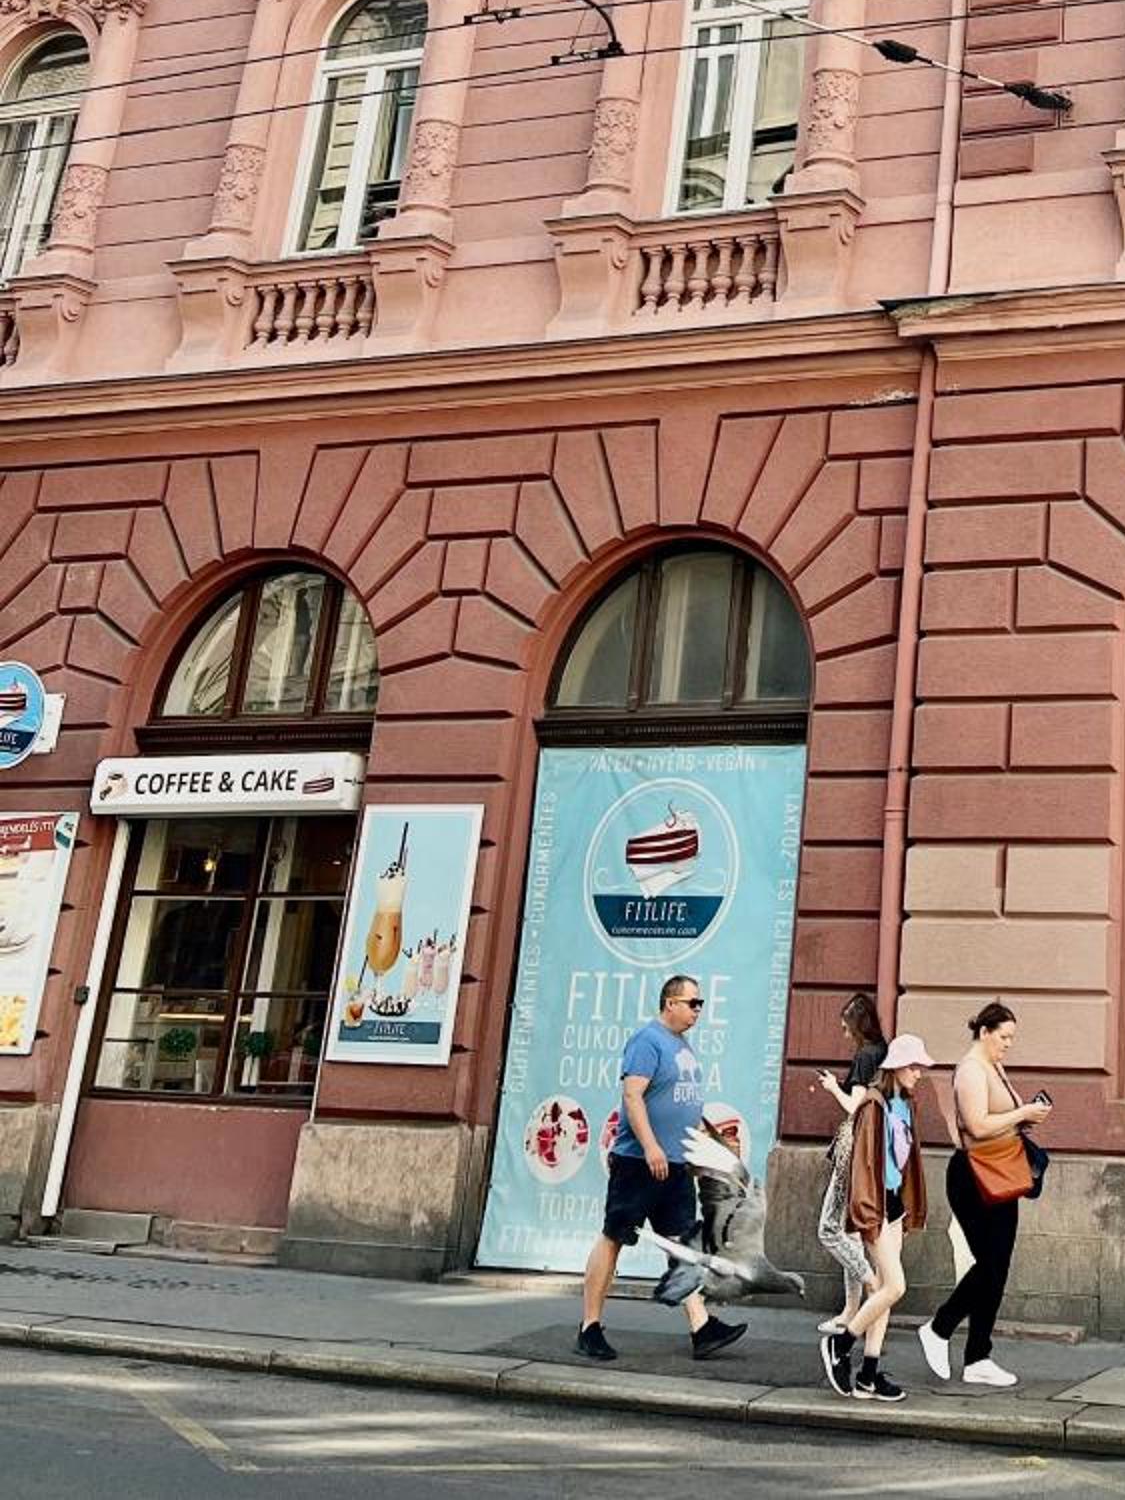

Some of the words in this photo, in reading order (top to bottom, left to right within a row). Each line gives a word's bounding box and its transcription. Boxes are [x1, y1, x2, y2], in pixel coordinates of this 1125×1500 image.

[134, 771, 213, 795] COFFEE
[218, 771, 235, 793] &
[241, 769, 298, 793] CAKE
[625, 901, 687, 922] FITLIFE
[567, 971, 732, 1025] FITLE
[539, 1191, 606, 1221] TORTA
